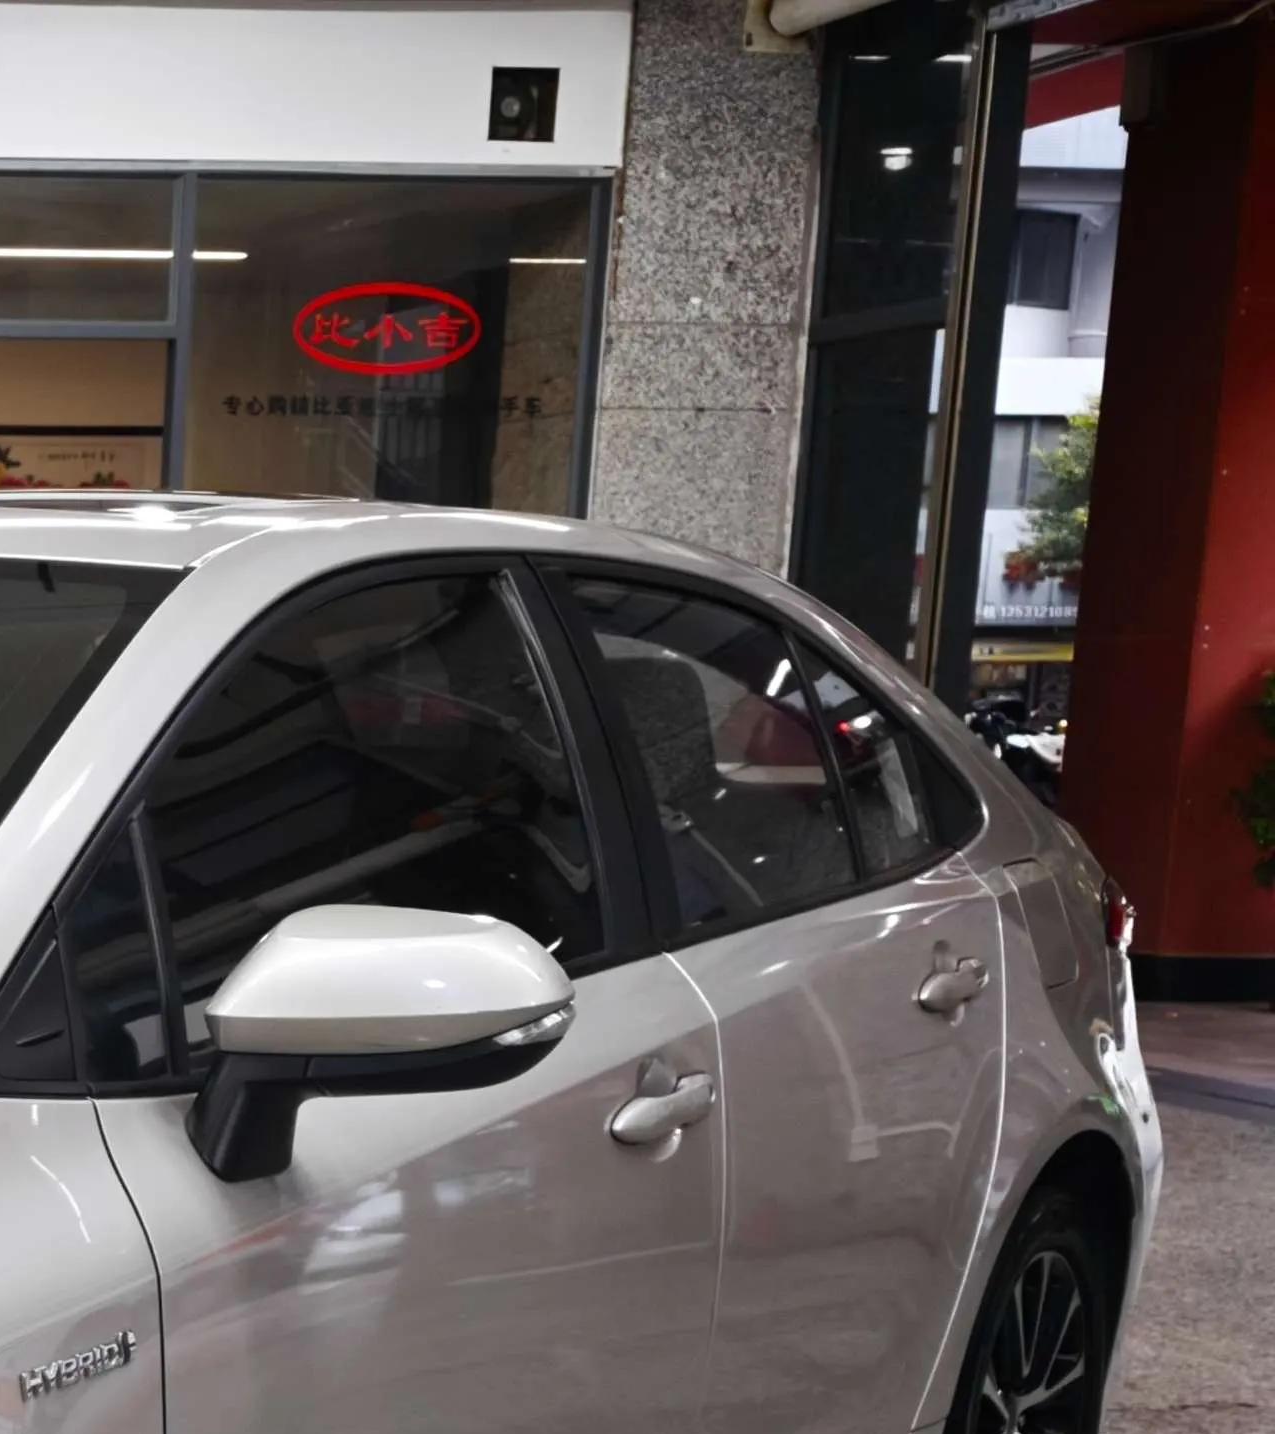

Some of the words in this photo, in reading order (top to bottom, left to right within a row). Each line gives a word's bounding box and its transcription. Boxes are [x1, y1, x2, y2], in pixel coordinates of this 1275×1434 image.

[308, 312, 469, 348] 比小吉
[19, 1337, 127, 1402] HYBRID
